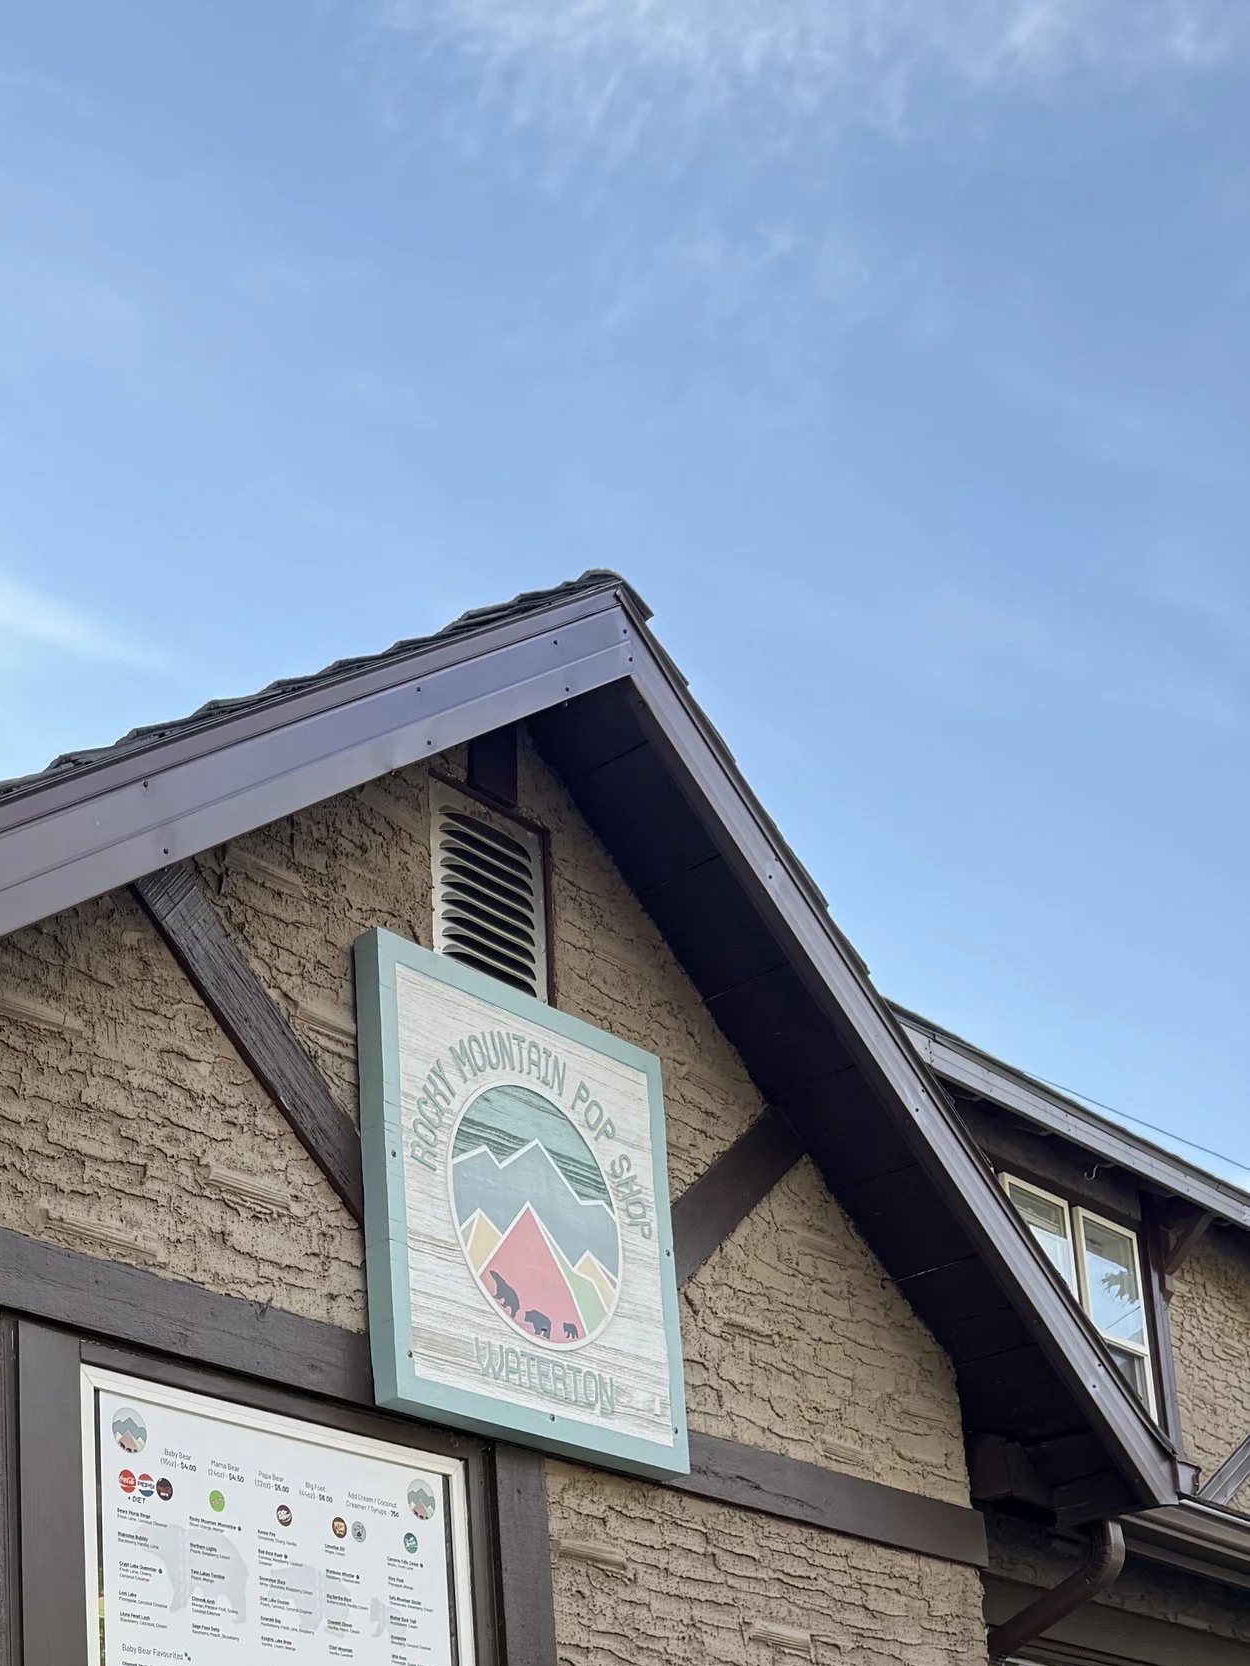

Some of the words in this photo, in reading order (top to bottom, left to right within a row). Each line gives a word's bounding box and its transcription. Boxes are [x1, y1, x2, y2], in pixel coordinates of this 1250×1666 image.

[410, 1057, 458, 1173] ROCKY
[450, 1030, 566, 1096] MOUNTAIN
[571, 1080, 617, 1143] POP
[610, 1153, 653, 1241] SHOP
[473, 1336, 616, 1416] WATERTON
[164, 1448, 177, 1459] Baby
[179, 1452, 191, 1460] Bear
[211, 1460, 226, 1469] Mama
[228, 1463, 240, 1472] Bear
[272, 1473, 284, 1482] Bear
[133, 1496, 145, 1504] DIET
[122, 1644, 137, 1654] Baby
[138, 1646, 151, 1655] Bear
[153, 1649, 183, 1660] Favourites
